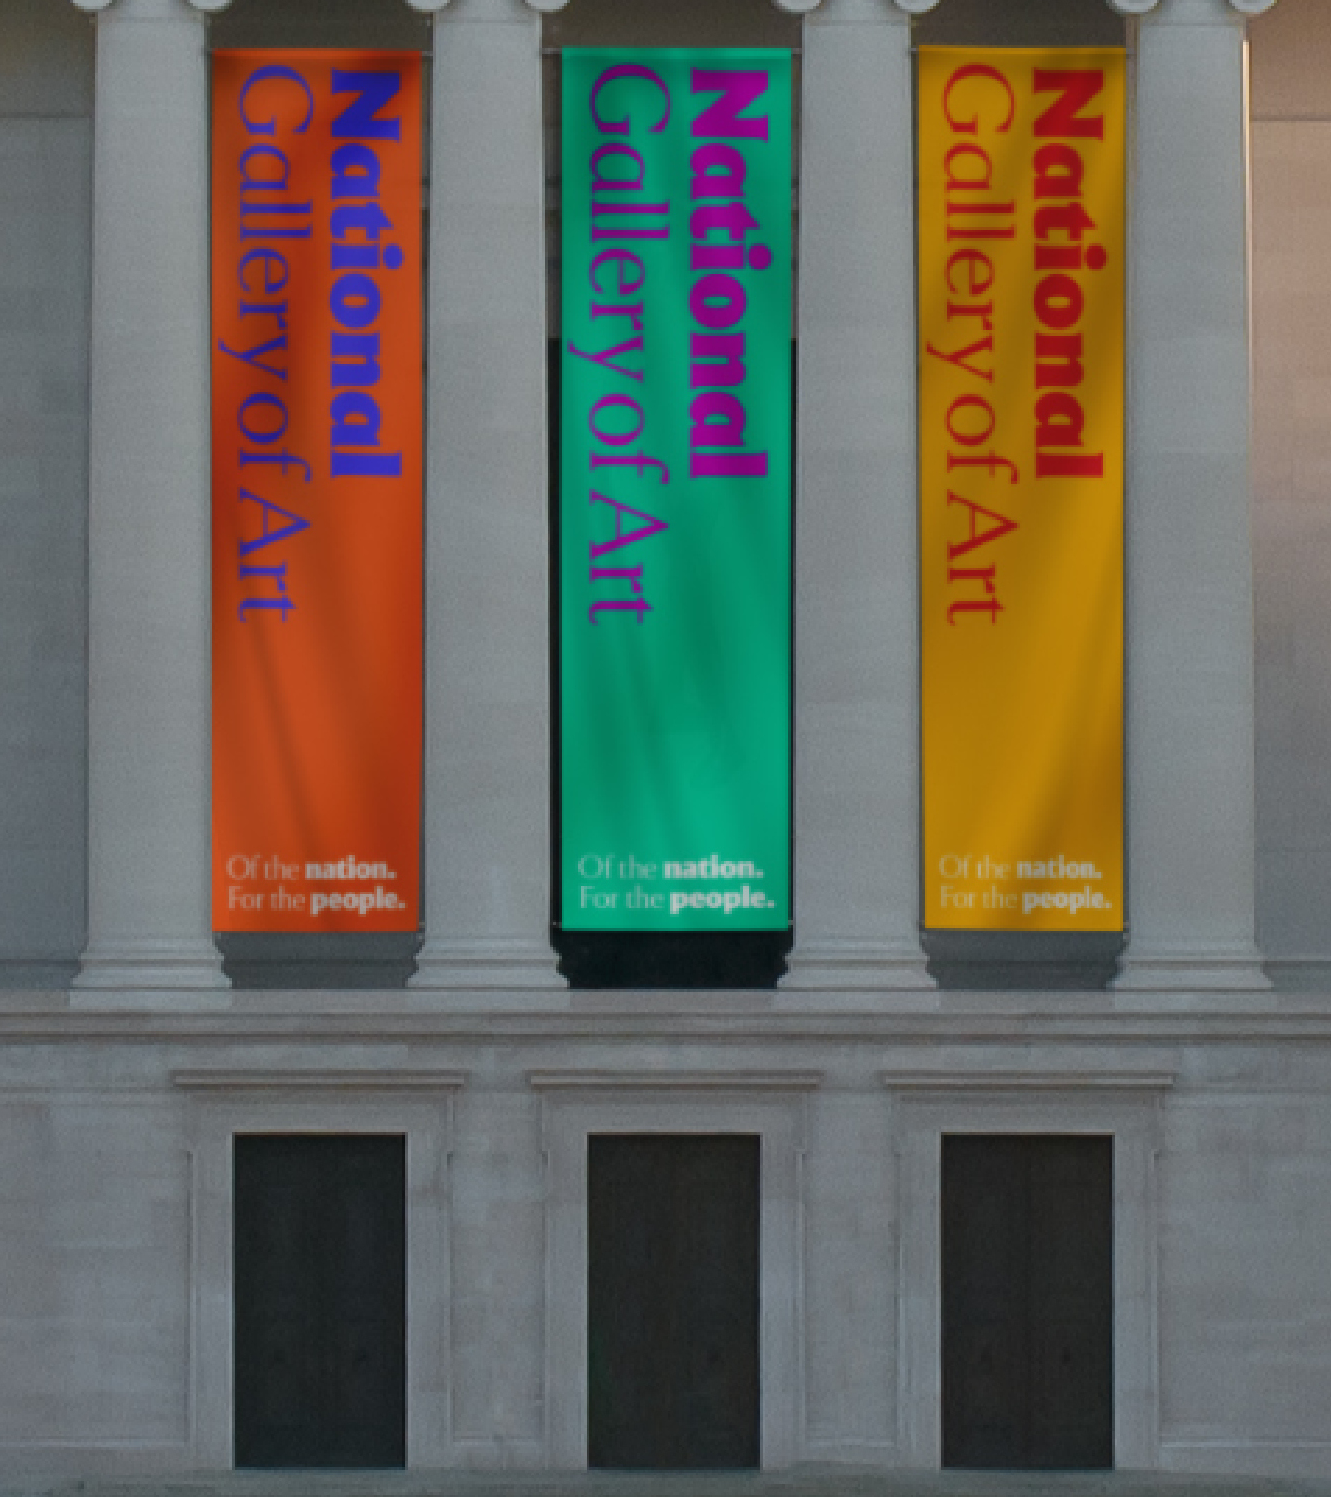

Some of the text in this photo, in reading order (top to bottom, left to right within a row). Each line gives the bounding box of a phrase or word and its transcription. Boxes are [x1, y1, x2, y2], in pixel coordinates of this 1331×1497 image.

[218, 64, 314, 624] Gallery of Art
[329, 66, 405, 479] National
[566, 64, 671, 625] Gallery of Art
[689, 66, 772, 479] National
[926, 64, 1019, 625] Gallery of Art
[1033, 66, 1107, 479] National
[226, 853, 397, 881] Of the nation.
[228, 883, 408, 918] For the people.
[577, 852, 764, 879] Of the nation.
[580, 883, 776, 917] For the people.
[938, 853, 1103, 880] Of the nation.
[940, 883, 1113, 916] For the people.
